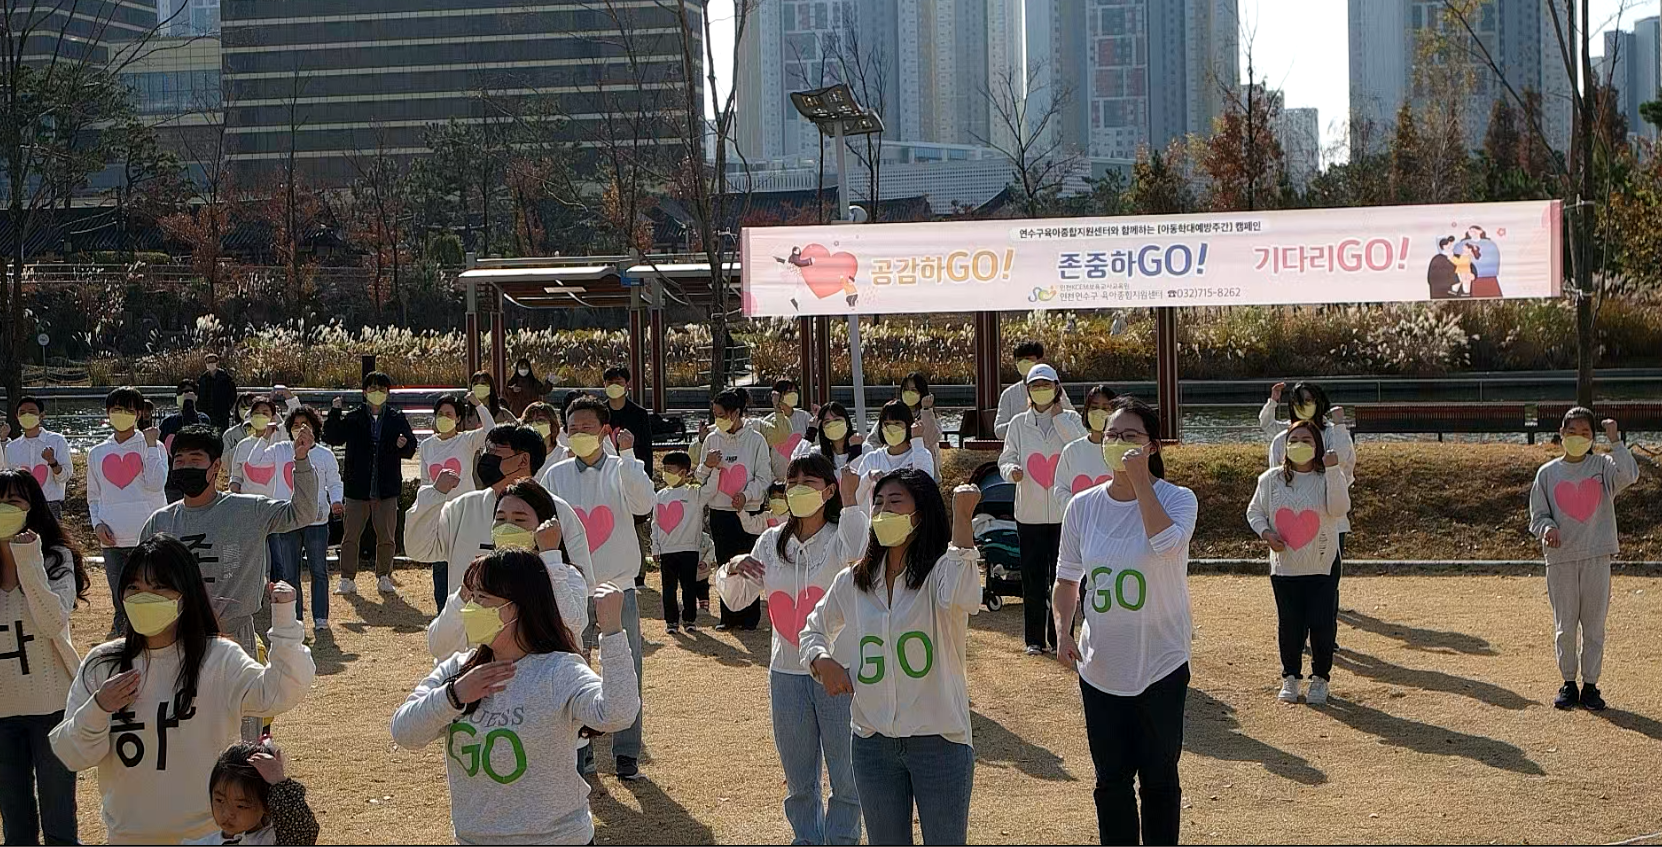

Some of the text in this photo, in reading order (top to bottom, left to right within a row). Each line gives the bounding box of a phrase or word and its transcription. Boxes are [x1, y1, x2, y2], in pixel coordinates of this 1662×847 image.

[1019, 221, 1261, 239] 연수구육아종합지원센터와 함께하는 [아동학대예방주간] 캠페인
[870, 248, 1015, 285] 공감하GO!
[1058, 243, 1209, 280] 존중하GO!
[1254, 237, 1410, 273] 기다리GO!
[1090, 566, 1148, 613] GO
[857, 630, 934, 685] GO
[109, 701, 179, 771] 하
[447, 722, 528, 785] GO
